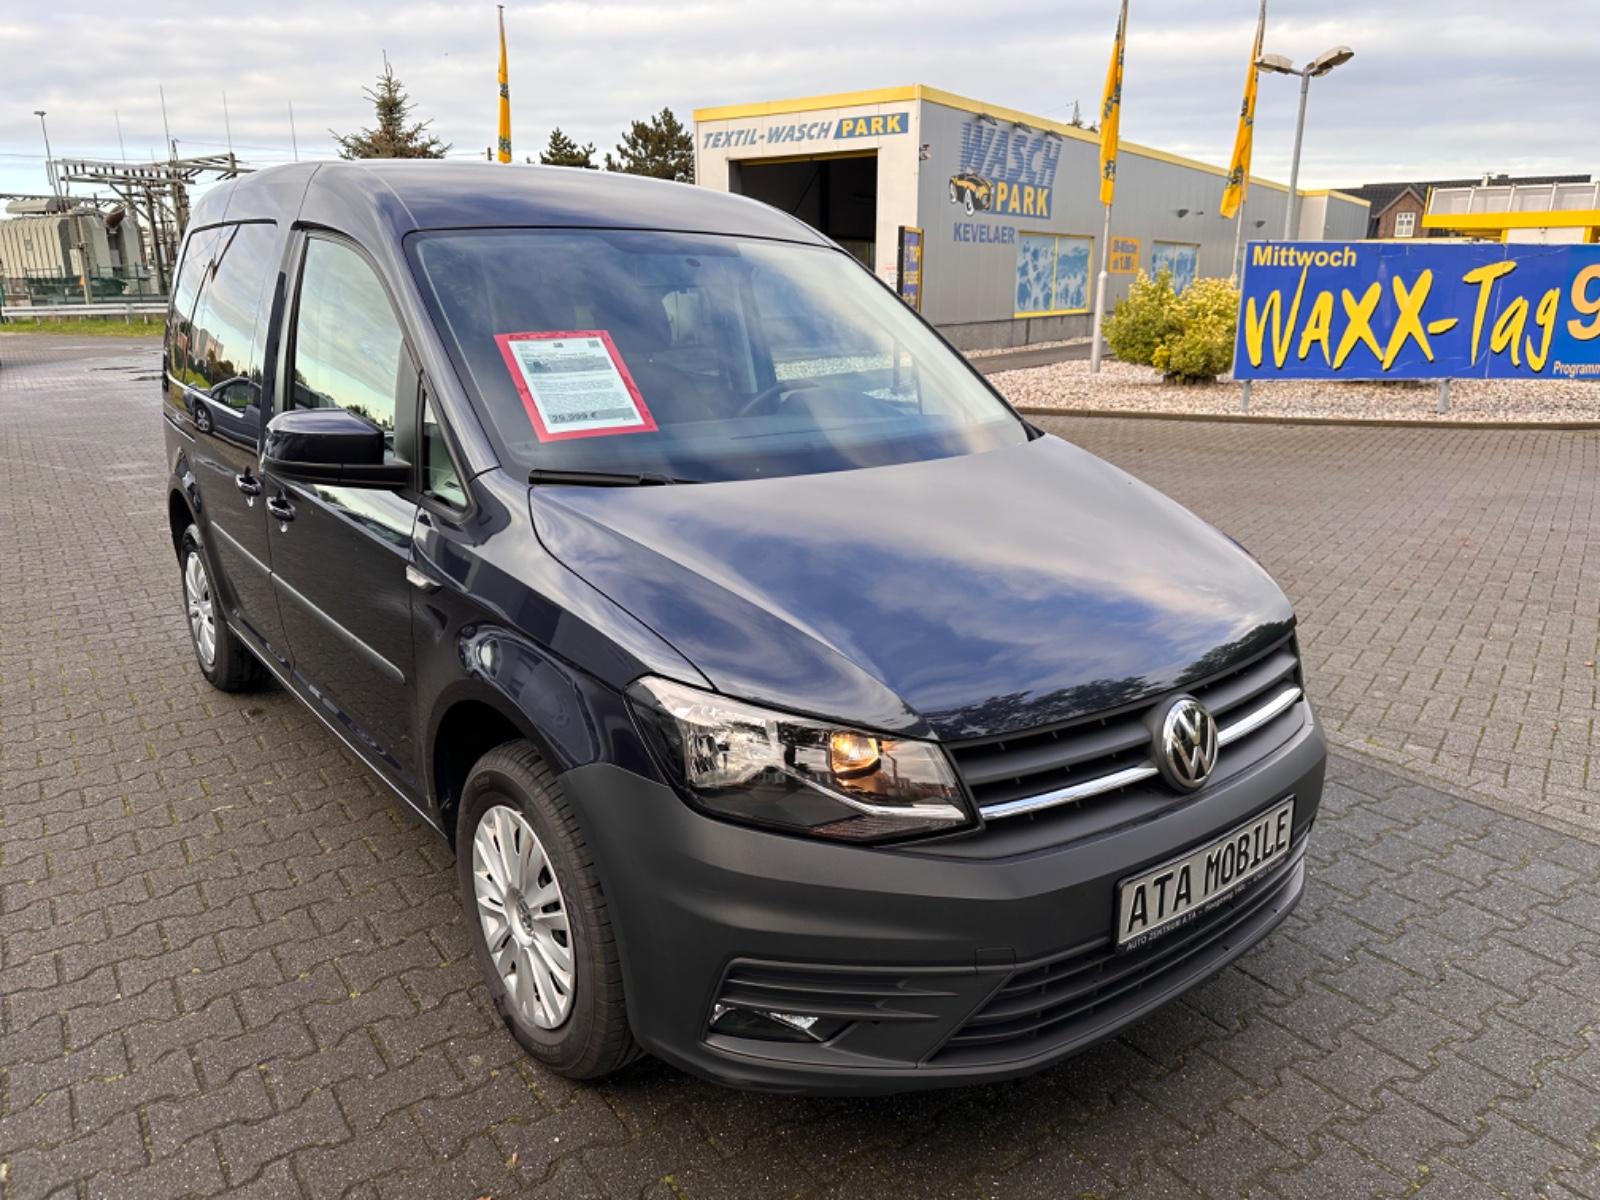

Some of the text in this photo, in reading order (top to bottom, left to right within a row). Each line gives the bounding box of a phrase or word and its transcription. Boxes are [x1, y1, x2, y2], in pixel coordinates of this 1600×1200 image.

[703, 114, 901, 149] TEXTIL-WASCH PARK
[959, 120, 1062, 187] WASCH
[996, 183, 1049, 217] PARK
[953, 222, 1015, 244] KEVELAER
[1252, 245, 1357, 267] Mittwoch
[1127, 808, 1289, 933] ATA MOBILE
